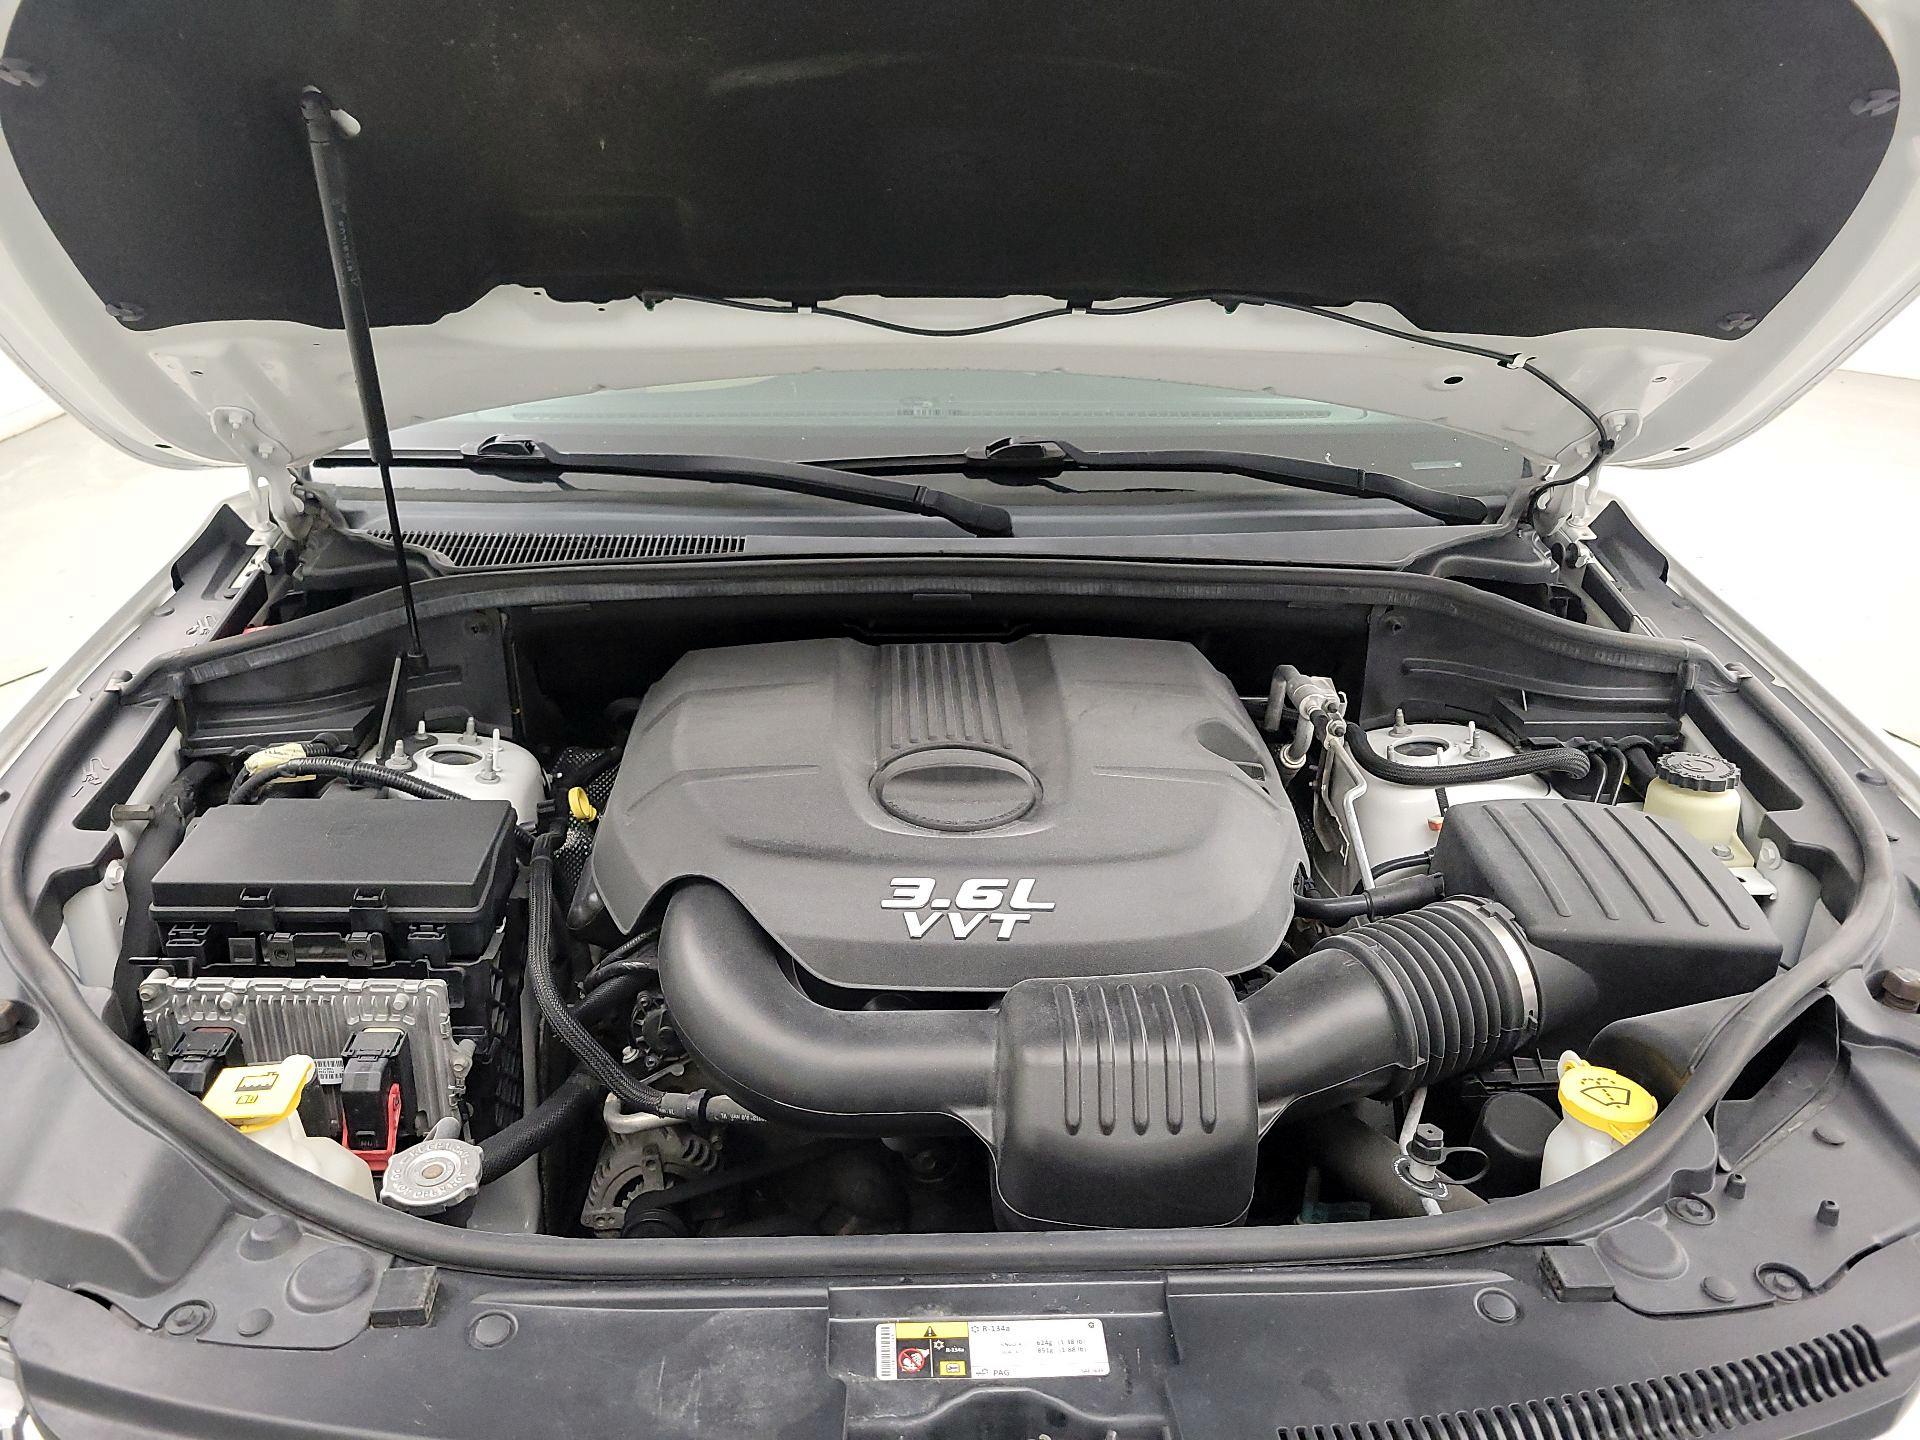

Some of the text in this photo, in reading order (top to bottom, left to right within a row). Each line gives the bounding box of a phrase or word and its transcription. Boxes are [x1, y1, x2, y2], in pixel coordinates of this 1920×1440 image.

[881, 877, 1055, 912] 3.6L
[903, 911, 1032, 941] VVT
[993, 1369, 1010, 1377] PAG
